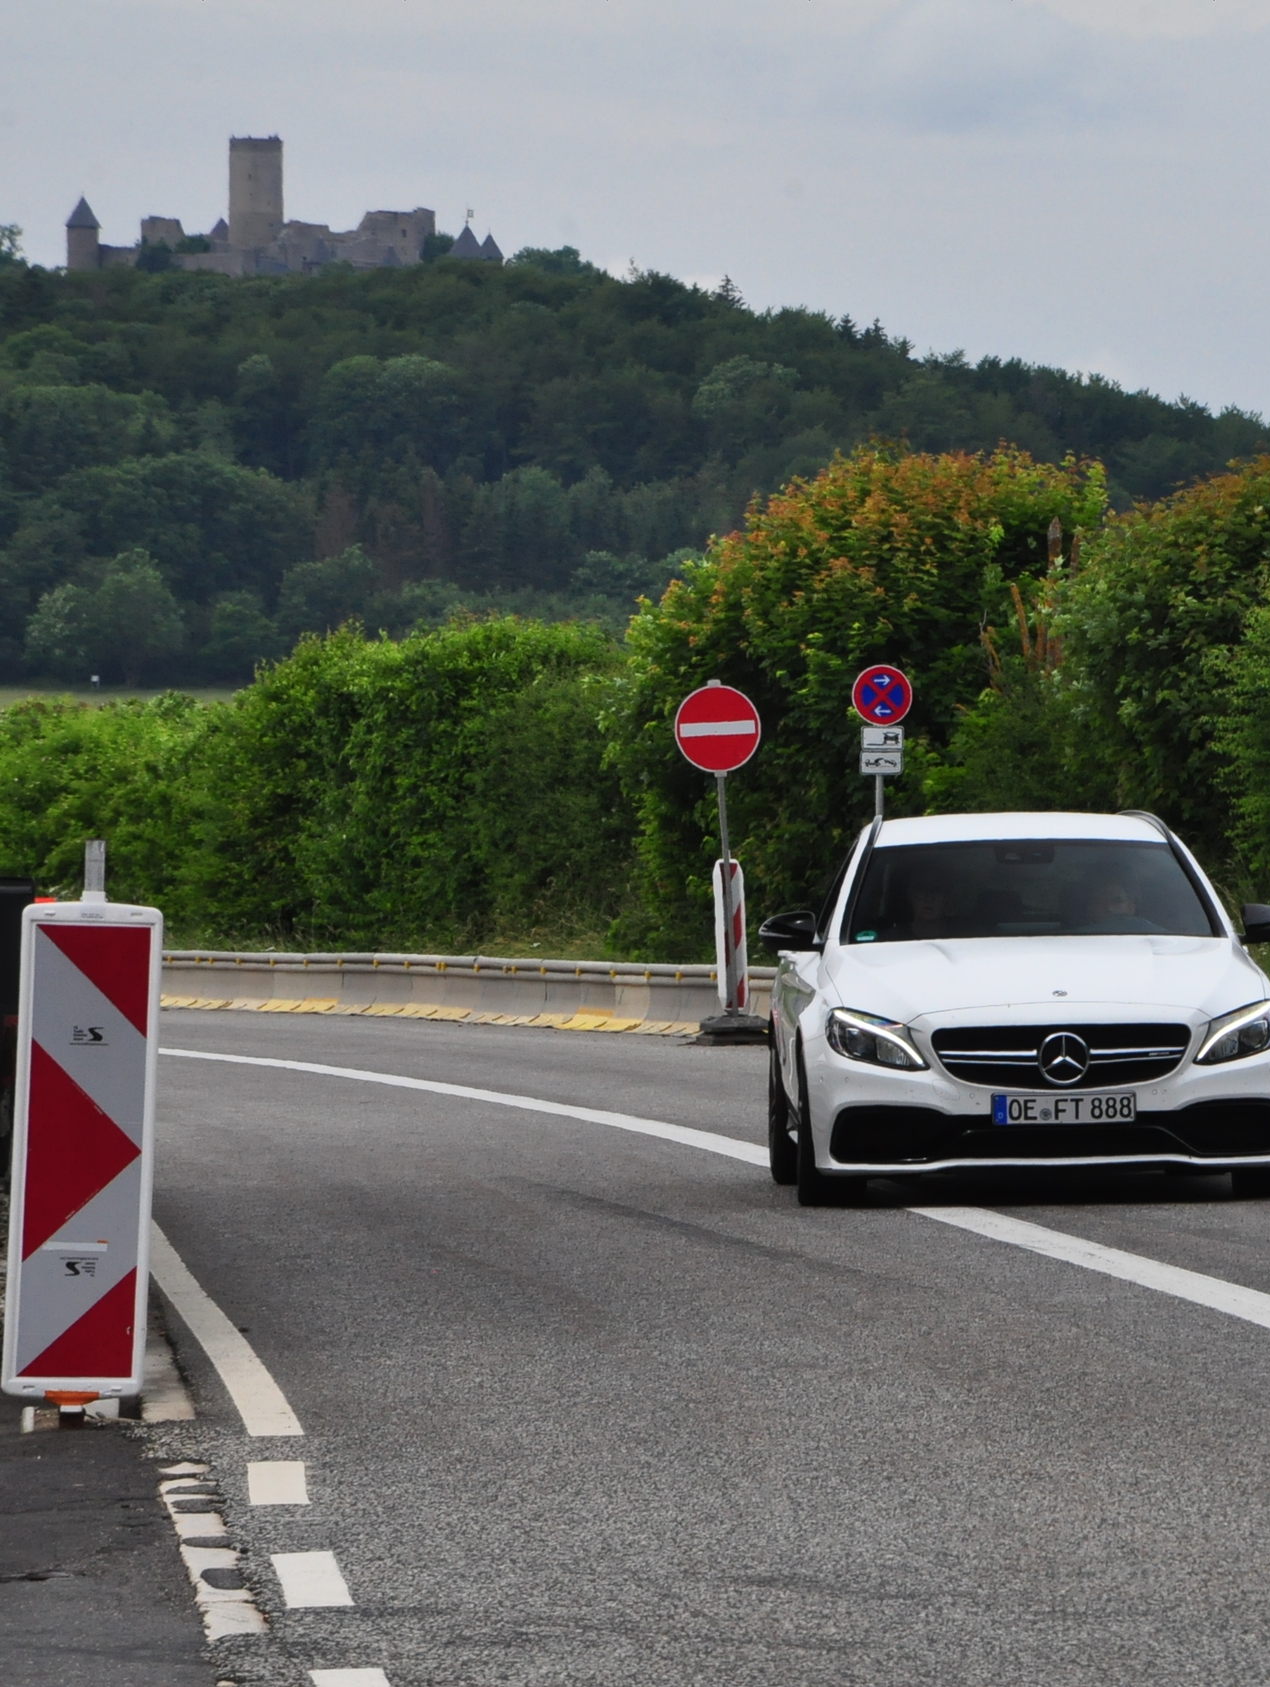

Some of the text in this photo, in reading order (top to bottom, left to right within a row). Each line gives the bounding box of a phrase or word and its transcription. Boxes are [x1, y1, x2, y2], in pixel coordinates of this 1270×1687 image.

[1008, 1097, 1132, 1121] OE FT 888
